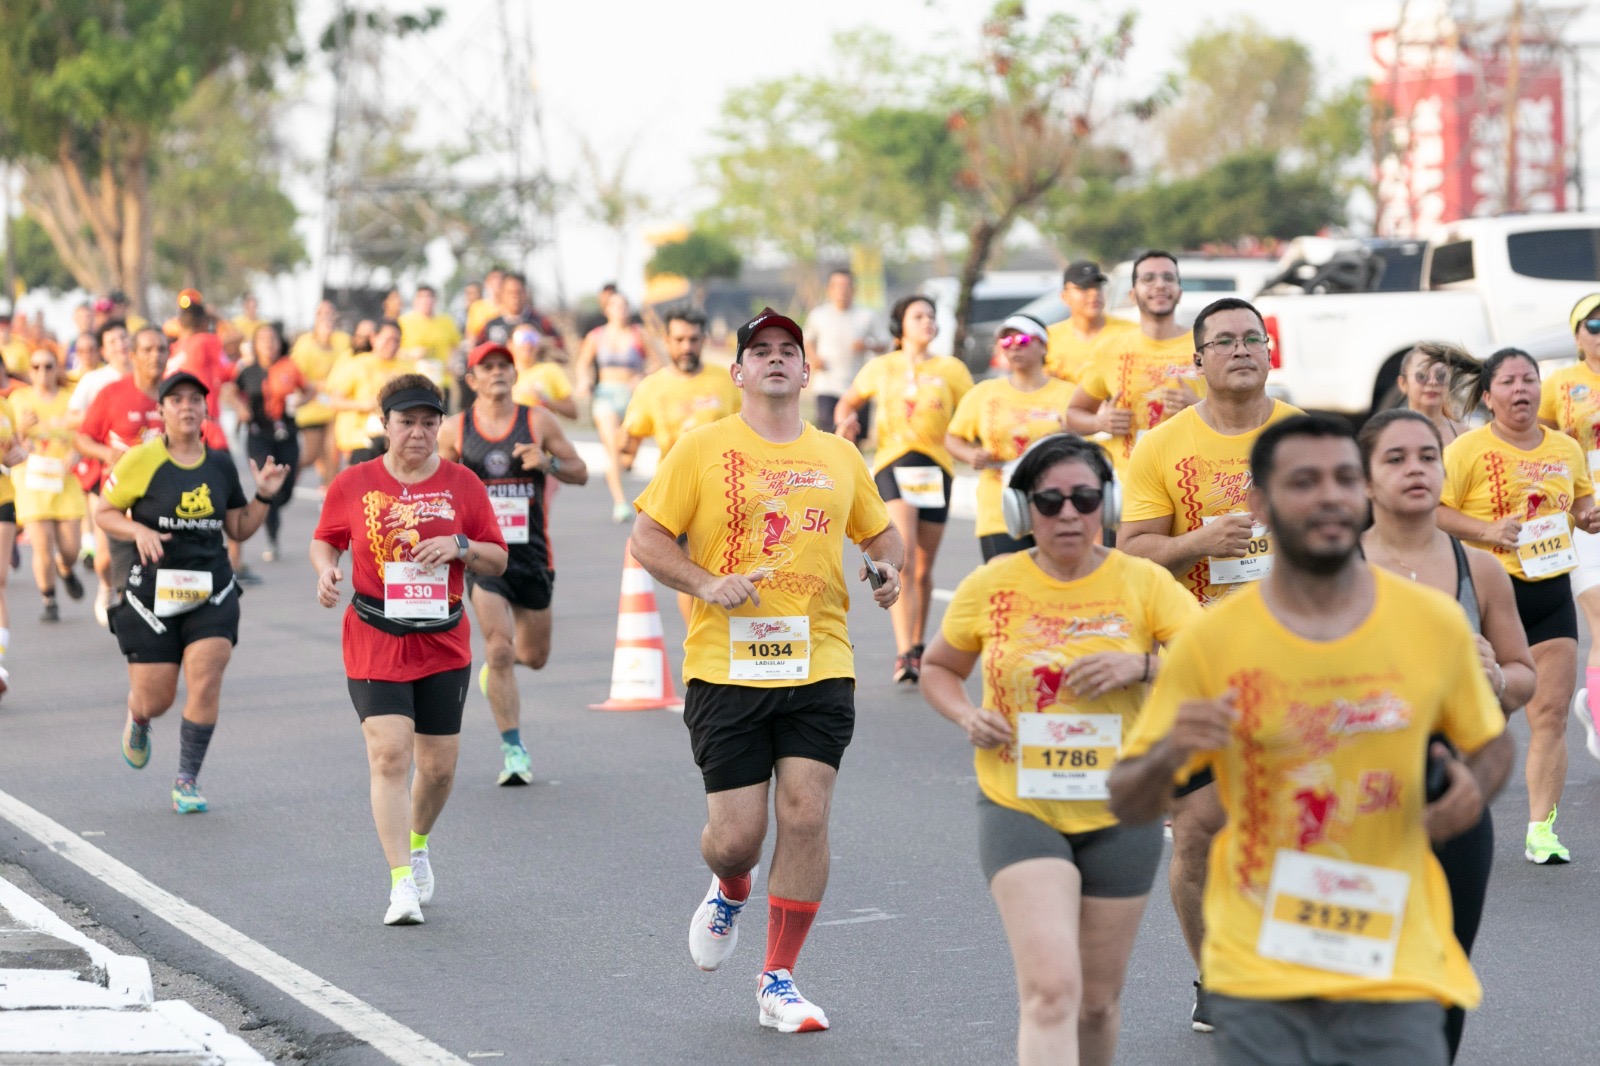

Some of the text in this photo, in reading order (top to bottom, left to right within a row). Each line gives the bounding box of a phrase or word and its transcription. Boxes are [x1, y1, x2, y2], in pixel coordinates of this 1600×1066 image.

[1221, 472, 1244, 488] COR
[485, 483, 535, 497] CURAS
[1231, 493, 1247, 506] DA
[158, 516, 223, 530] RUNNERS
[1531, 537, 1562, 555] 1112
[1240, 558, 1257, 566] BILLY
[169, 589, 200, 599] 1959
[404, 585, 433, 598] 330
[748, 643, 793, 657] 1034
[1041, 749, 1098, 767] 1786
[1297, 900, 1370, 933] 2137
